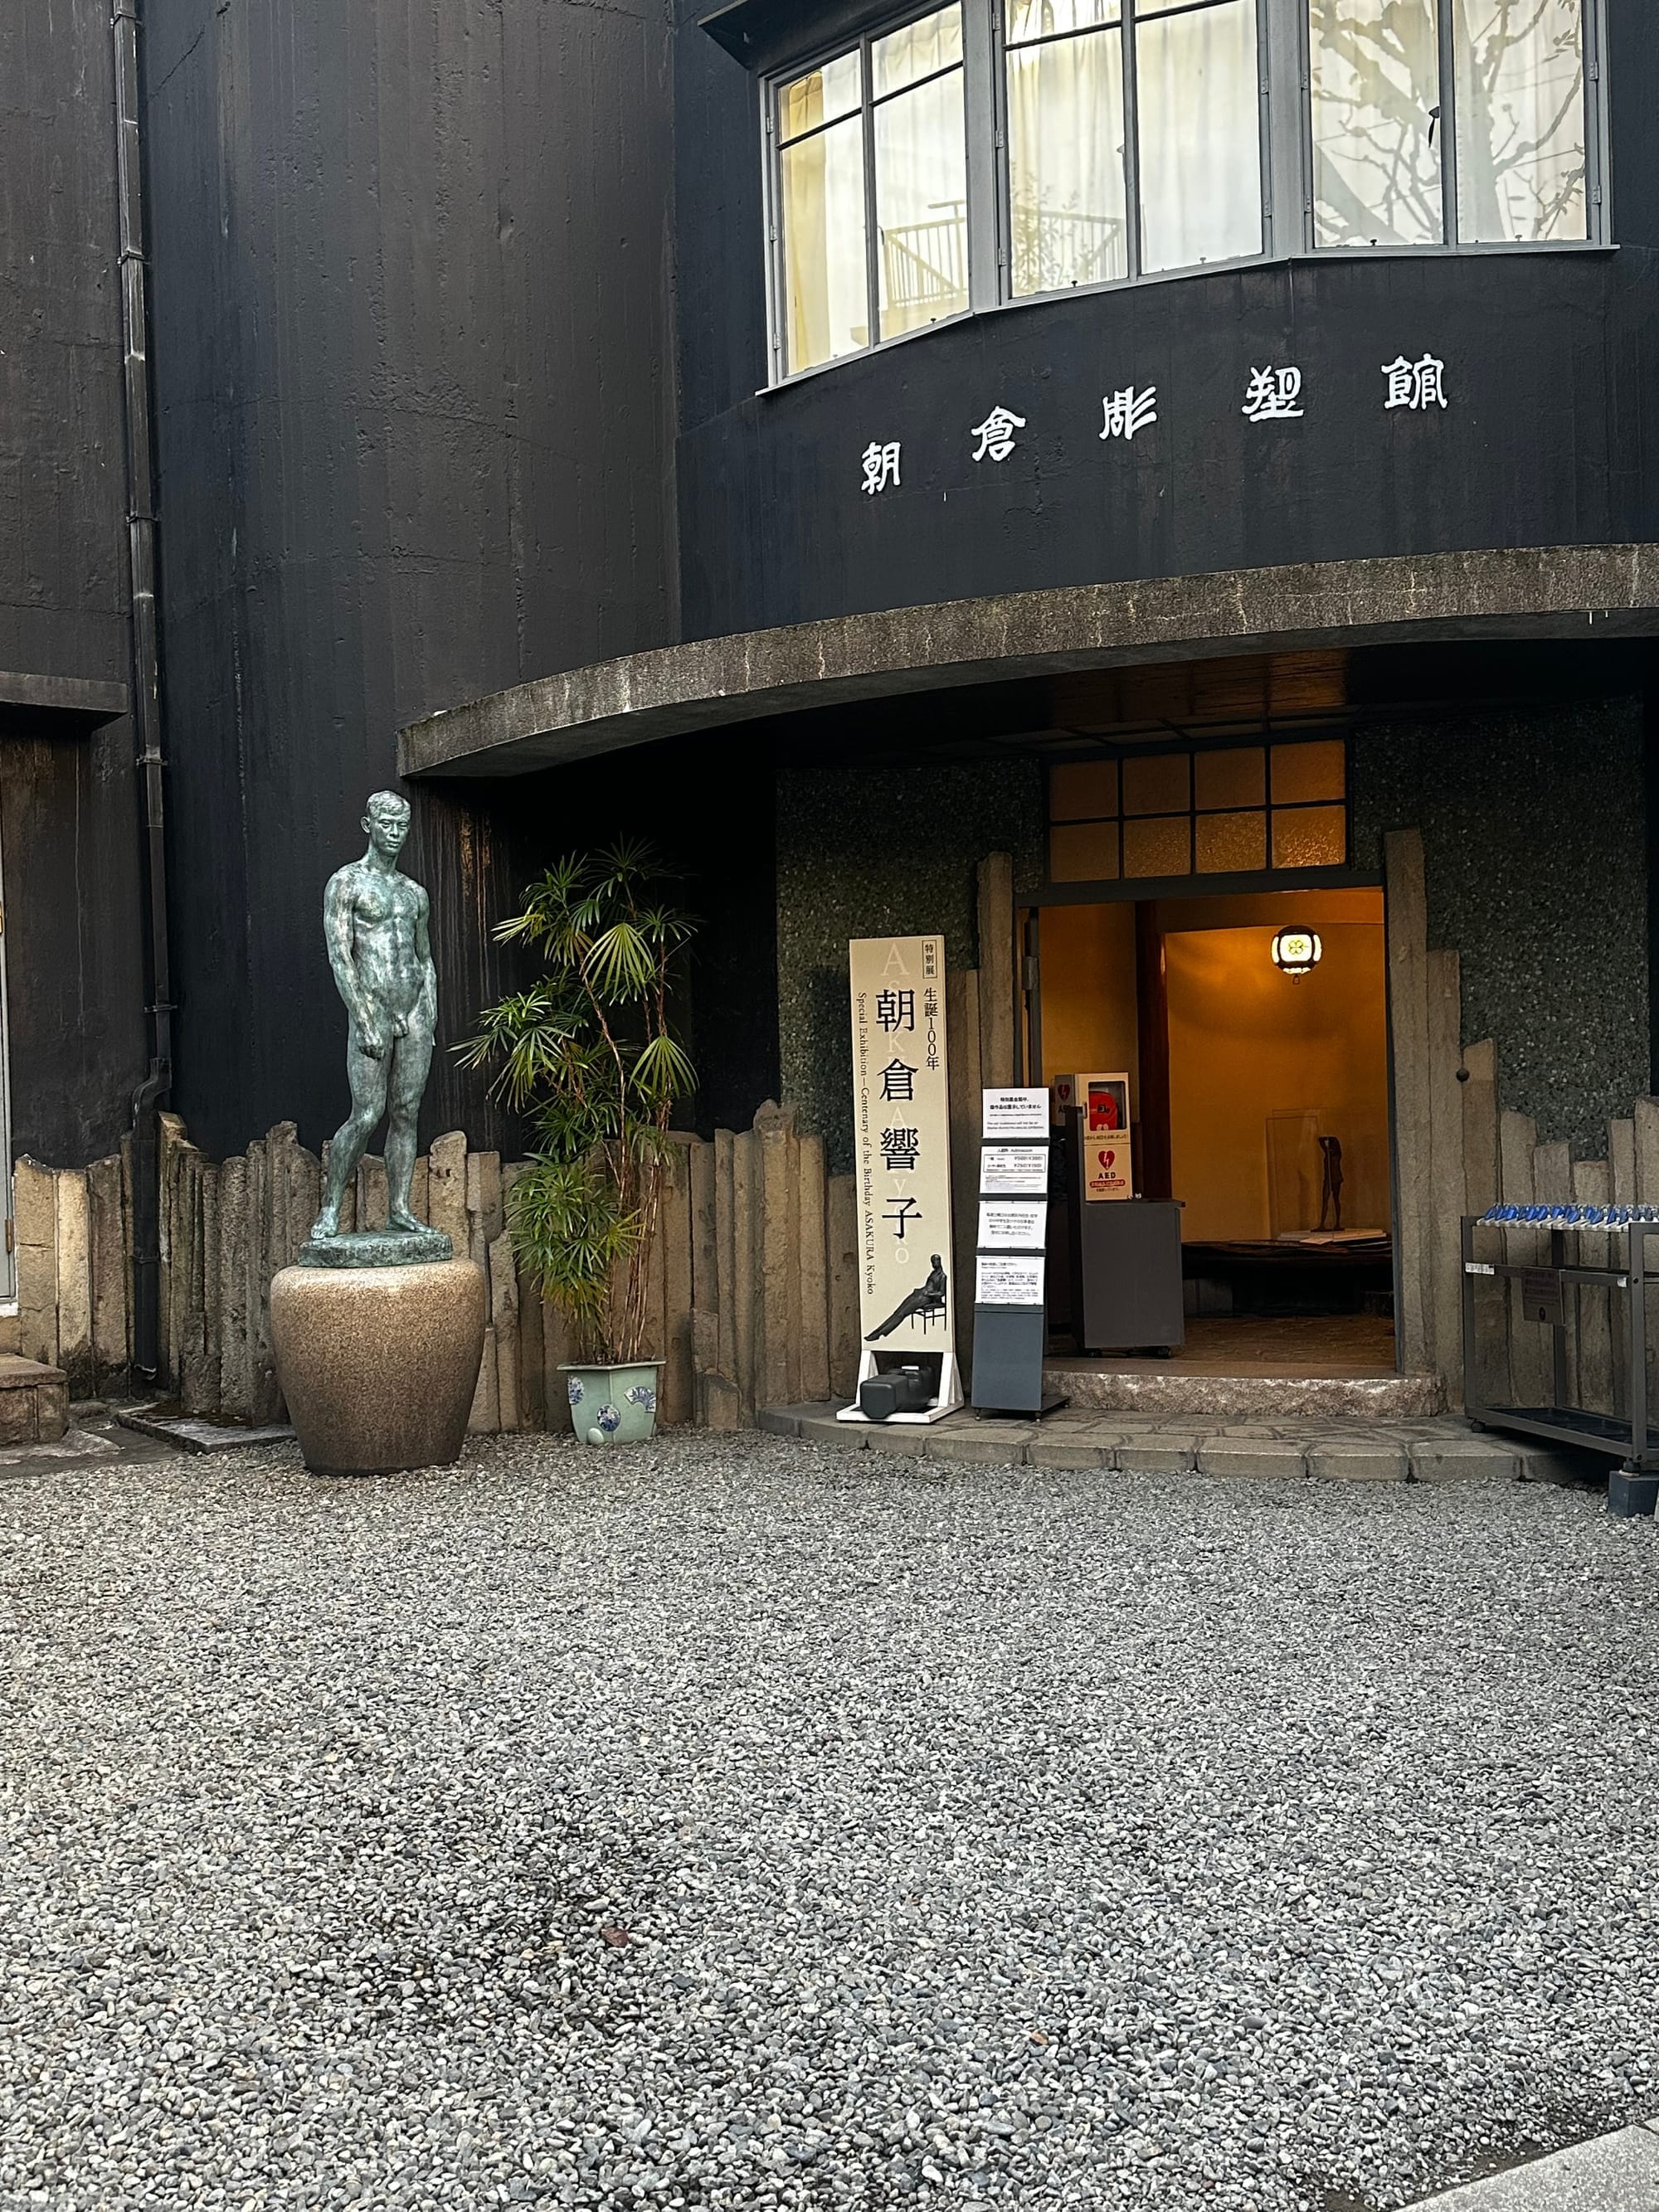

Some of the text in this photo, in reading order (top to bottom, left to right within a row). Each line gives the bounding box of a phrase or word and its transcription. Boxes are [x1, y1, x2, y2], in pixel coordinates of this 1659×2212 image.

[860, 353, 1447, 495] 朝倉彫塑館
[924, 944, 935, 975] 特別展
[856, 992, 868, 1023] Special
[923, 987, 940, 1071] 生誕100年
[875, 989, 922, 1239] 朝倉響子
[863, 1136, 873, 1148] of
[864, 1150, 873, 1164] the
[863, 1168, 873, 1206] Birthday
[864, 1210, 875, 1261] ASAKURA
[864, 1265, 876, 1295] Kyoko
